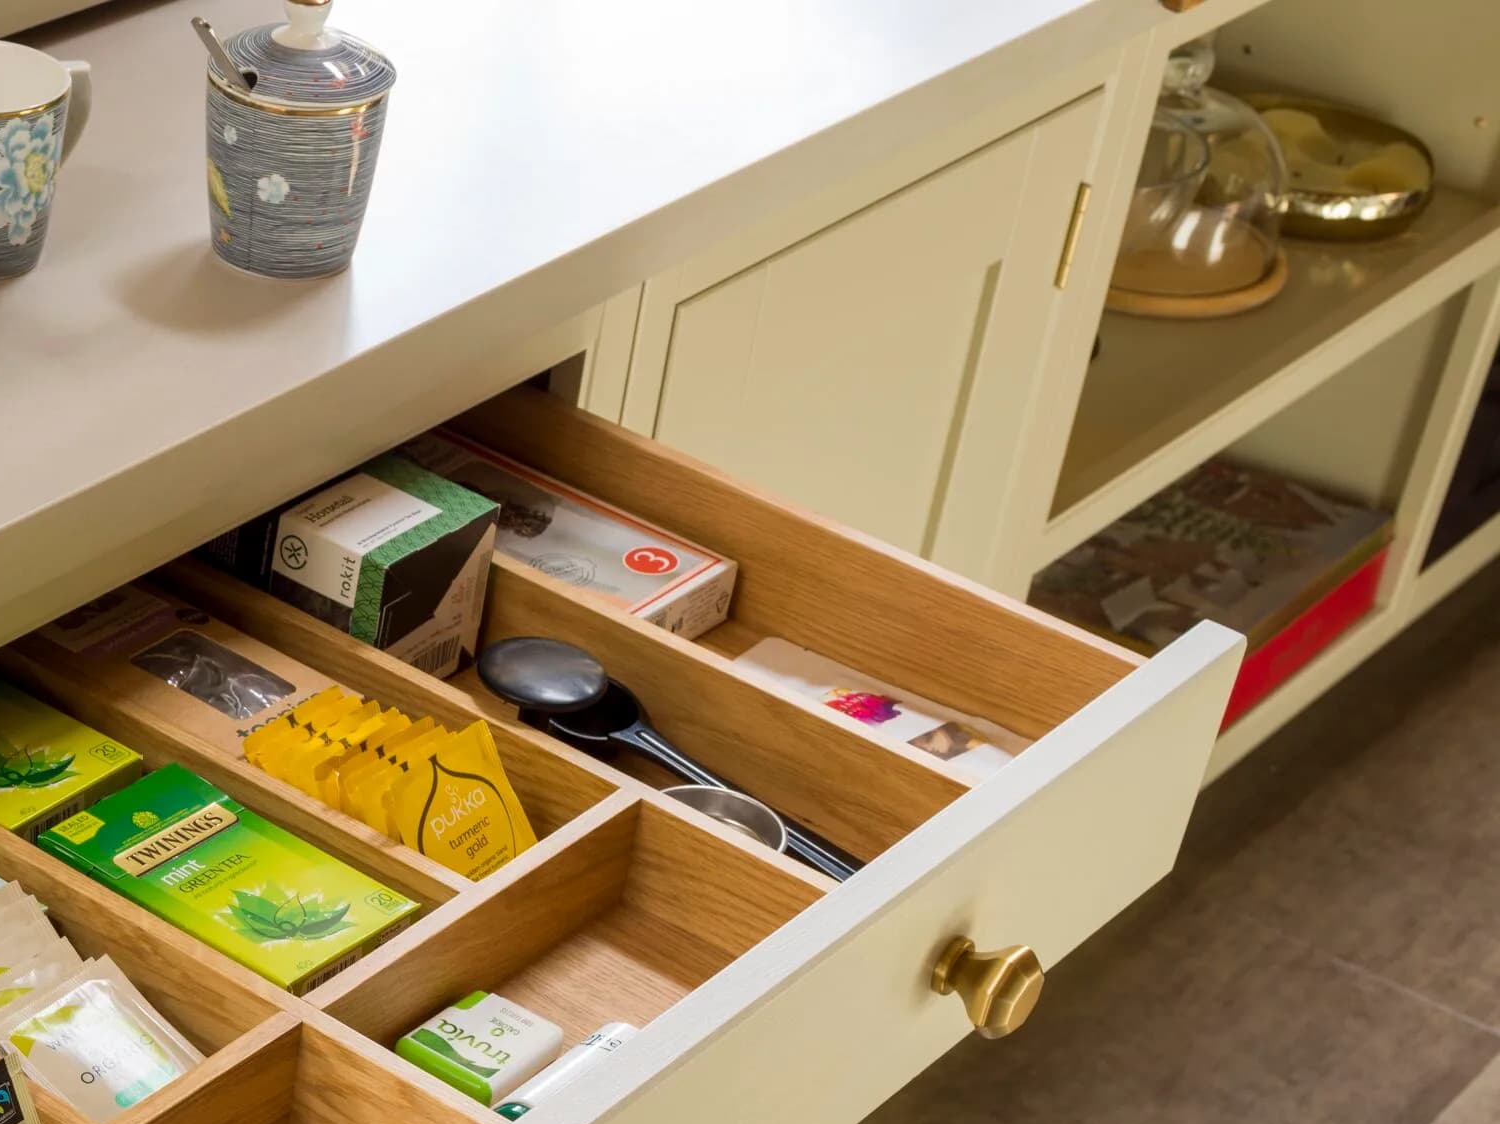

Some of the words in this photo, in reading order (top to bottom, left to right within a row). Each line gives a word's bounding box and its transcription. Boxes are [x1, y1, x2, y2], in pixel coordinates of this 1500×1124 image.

[339, 556, 357, 599] rokit
[430, 785, 486, 840] pukka
[449, 816, 491, 850] turmeric
[126, 811, 224, 867] TWININGS
[466, 834, 489, 860] gold
[160, 858, 206, 887] mint
[179, 862, 226, 894] GREEN
[218, 852, 251, 871] TEA
[436, 1018, 511, 1065] truvia
